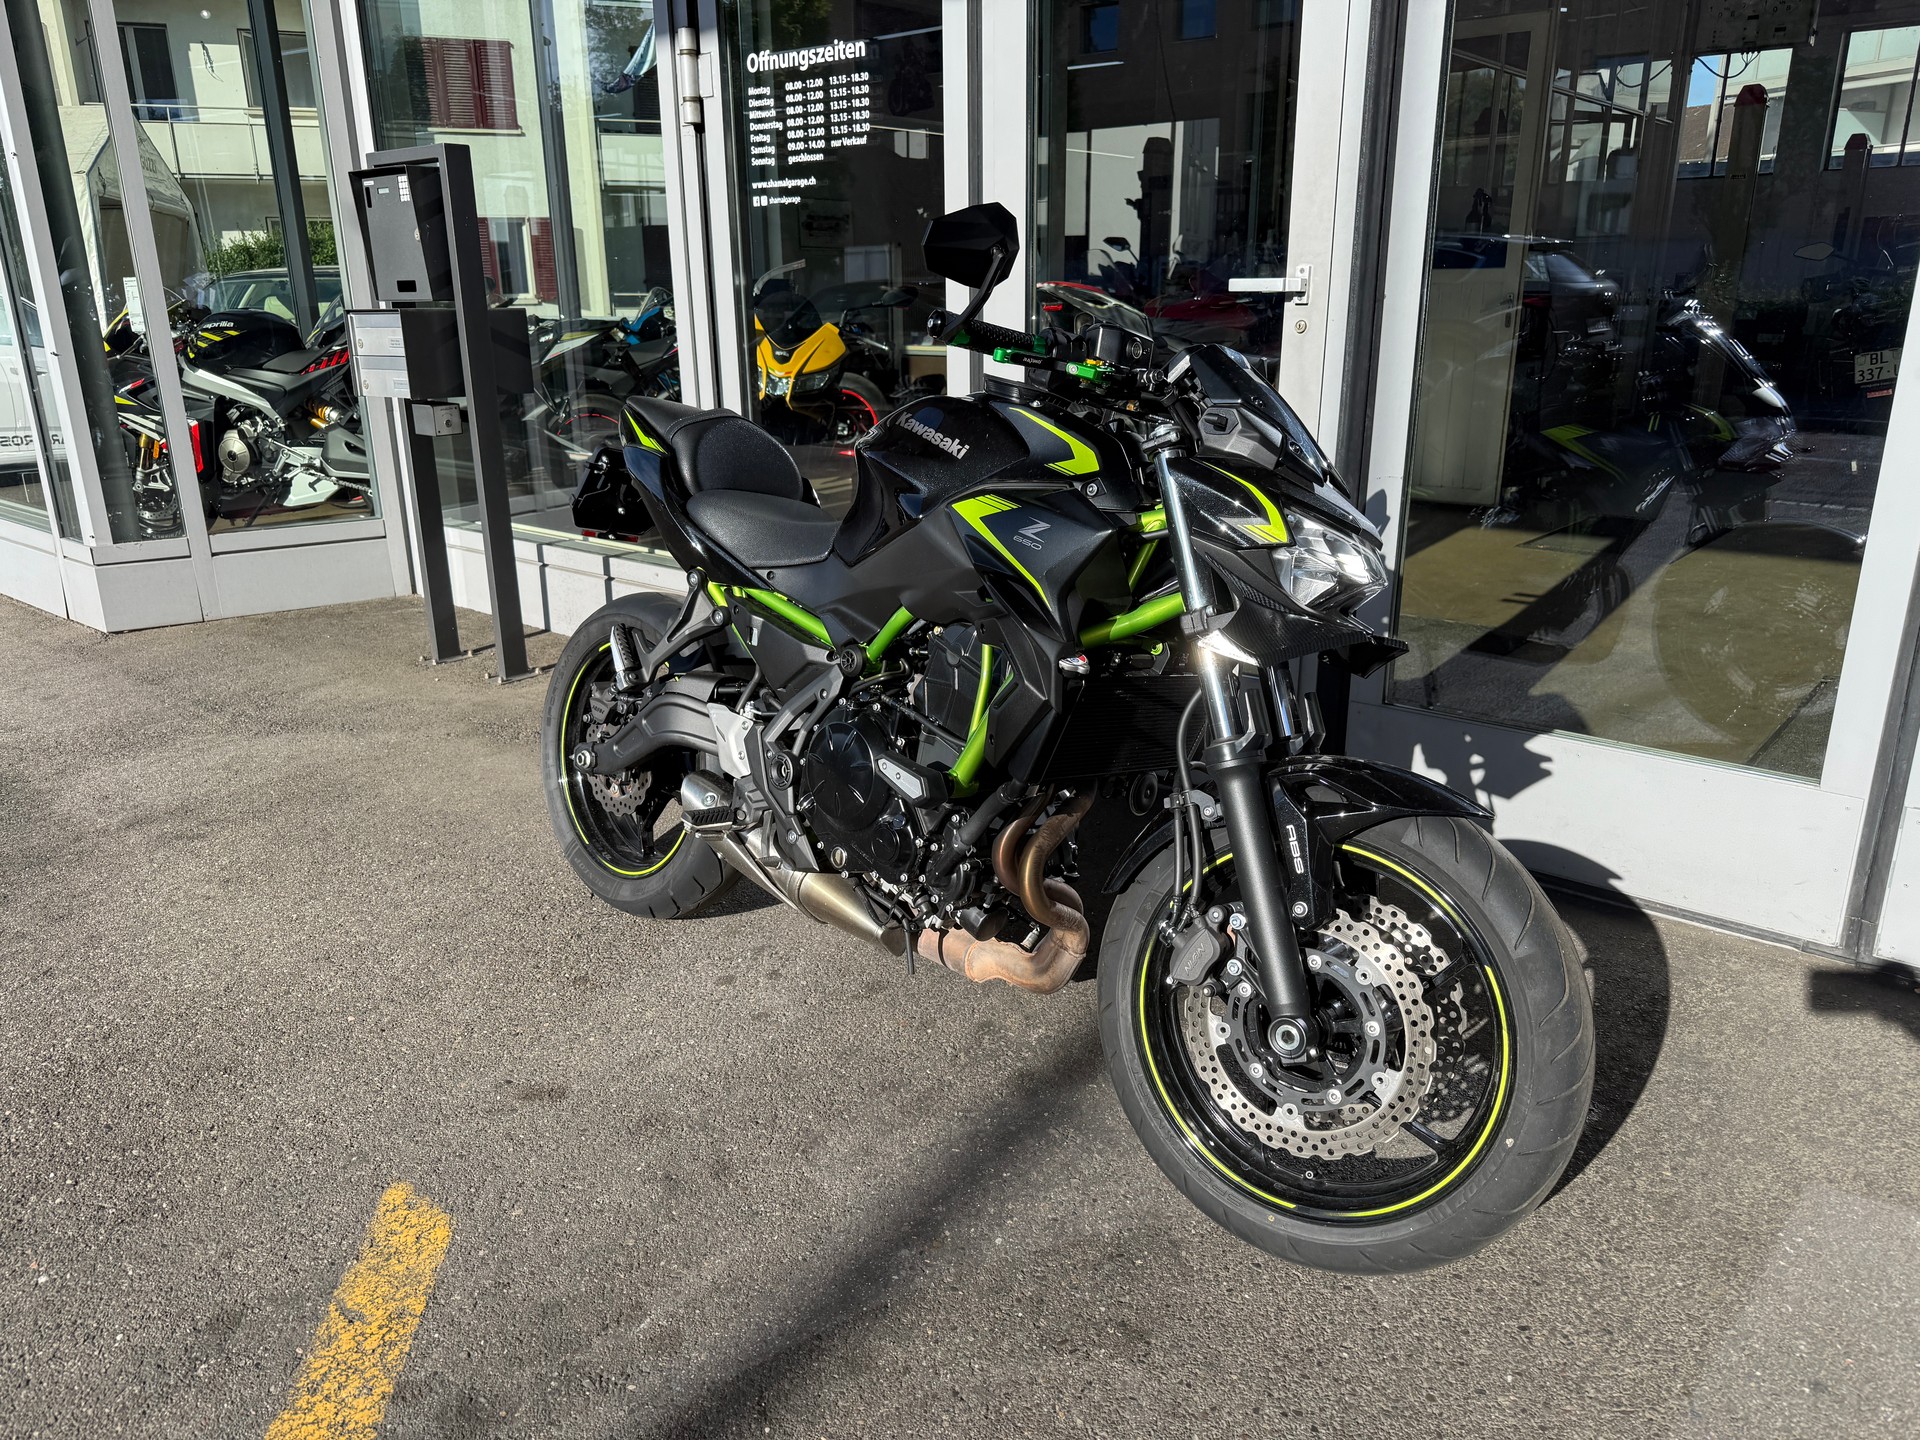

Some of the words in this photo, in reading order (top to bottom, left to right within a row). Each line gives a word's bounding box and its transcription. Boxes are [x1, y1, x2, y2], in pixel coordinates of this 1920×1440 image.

[748, 87, 770, 96] Montag
[785, 80, 802, 91] 08.00
[806, 78, 823, 88] 12.00
[829, 74, 846, 85] 13.15
[851, 72, 868, 82] 18.30
[749, 98, 774, 108] Dienstag
[786, 94, 802, 103] 08.00
[806, 90, 824, 100] 12.00
[830, 88, 847, 98] 13.15
[851, 84, 869, 94] 18.30
[749, 109, 776, 119] Mittwoch
[786, 105, 803, 115] 08.00
[807, 103, 824, 112] 12.00
[830, 101, 847, 110] 13.15
[852, 98, 869, 107] 18.30
[750, 121, 783, 131] Donnerstag
[787, 118, 803, 127] 08.00
[807, 115, 824, 125] 12.00
[830, 113, 847, 122] 13.15
[852, 110, 870, 120] 18.30
[750, 134, 770, 143] Freitag
[787, 129, 804, 139] 08.00
[808, 127, 825, 137] 12.00
[831, 125, 848, 135] 13.15
[852, 122, 870, 132] 18.30
[750, 145, 775, 154] Samstag
[788, 141, 804, 151] 09.00
[808, 140, 825, 149] 14.00
[831, 140, 842, 148] nur
[842, 135, 867, 145] Verkauf
[751, 157, 775, 166] Sonntag
[788, 153, 824, 165] geschlossen
[752, 176, 816, 189] www.shamalgarage.ch
[769, 196, 801, 205] shamalgarage
[203, 321, 234, 329] aprilia
[1870, 352, 1888, 365] BL
[896, 411, 970, 459] Kawasaki
[1013, 535, 1042, 550] 650
[1286, 825, 1304, 874] ABS
